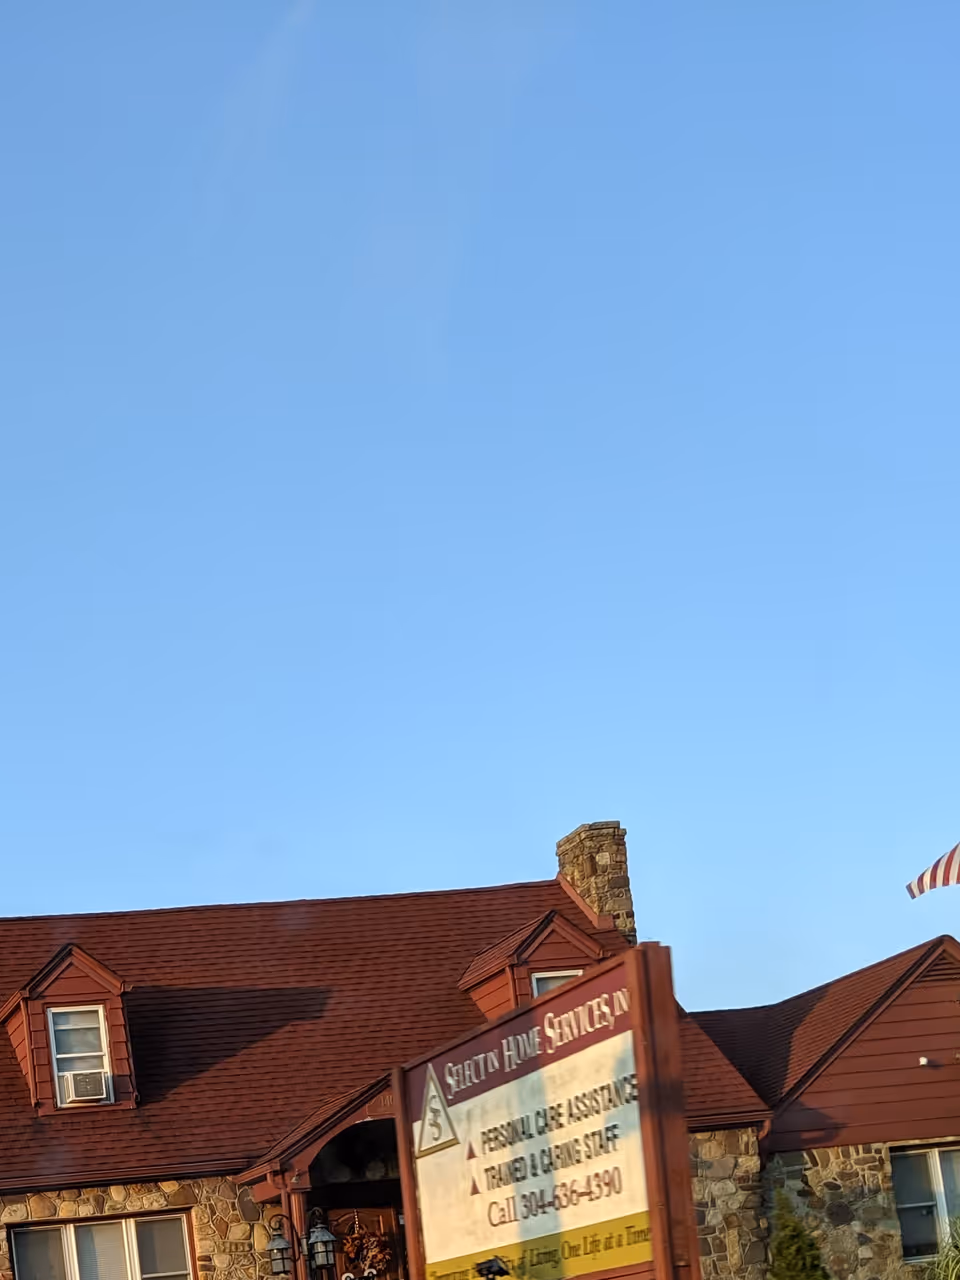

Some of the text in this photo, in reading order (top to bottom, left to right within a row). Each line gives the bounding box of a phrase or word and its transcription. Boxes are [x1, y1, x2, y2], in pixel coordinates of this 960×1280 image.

[444, 1053, 486, 1099] SELECT
[501, 1026, 542, 1072] HOME
[480, 1073, 638, 1154] PERSONAL CARE ASSISTANCE
[484, 1123, 620, 1191] TRAINED & CARING STAFF
[488, 1166, 622, 1227] Call 304-636-4390
[561, 1240, 581, 1260] One
[582, 1233, 601, 1261] Life
